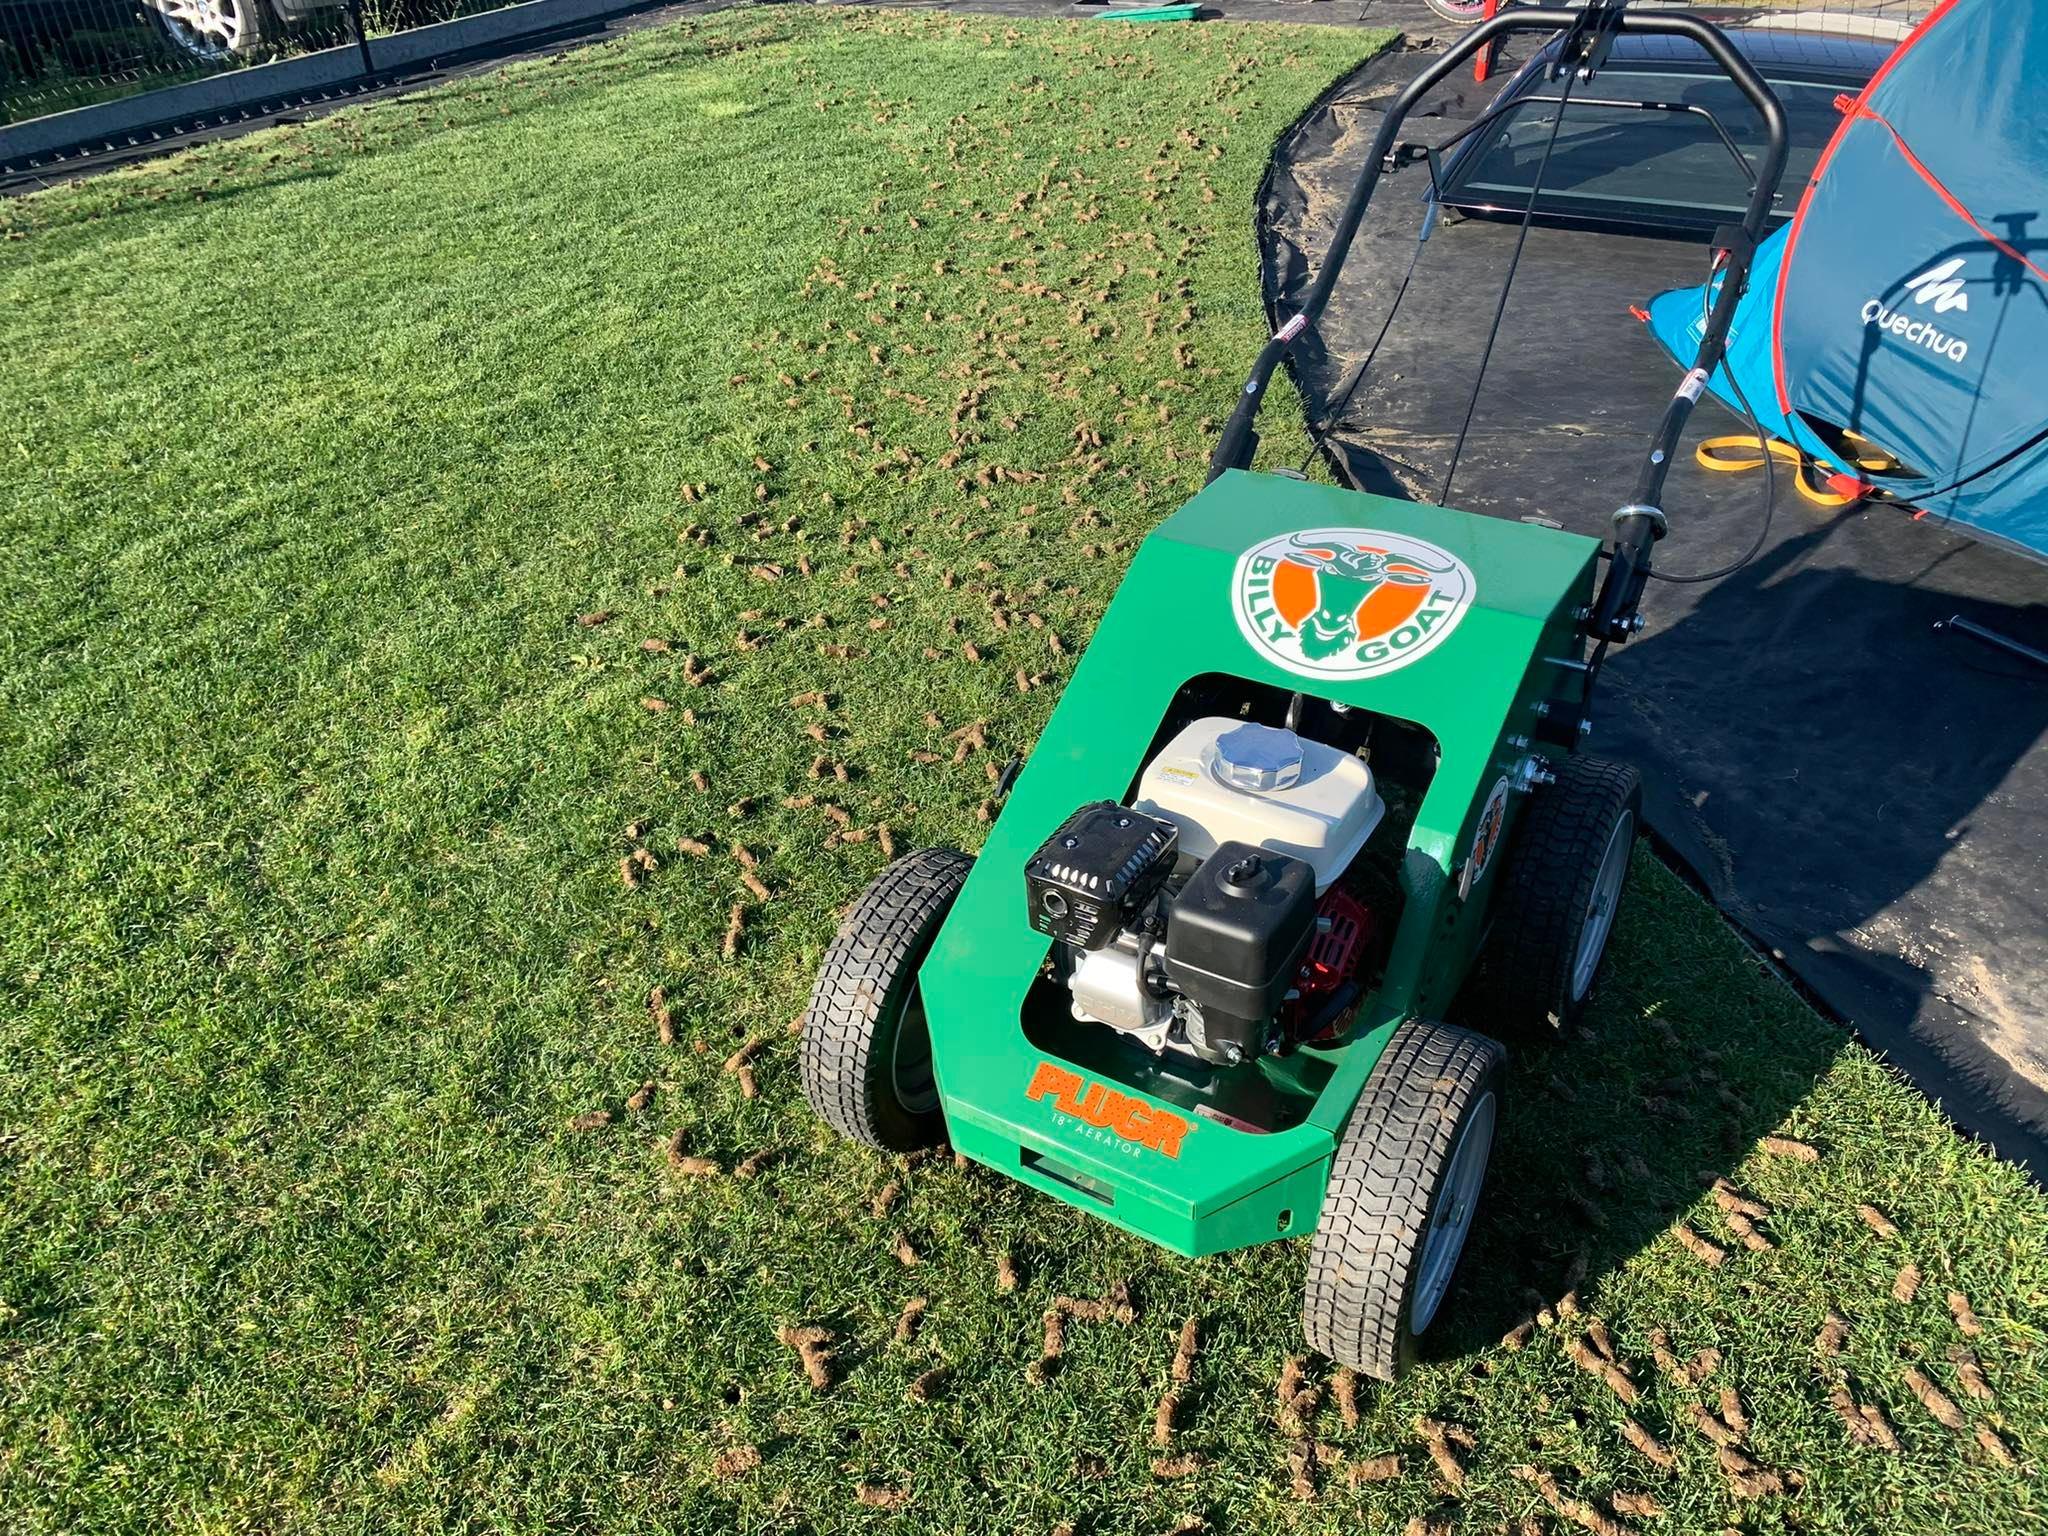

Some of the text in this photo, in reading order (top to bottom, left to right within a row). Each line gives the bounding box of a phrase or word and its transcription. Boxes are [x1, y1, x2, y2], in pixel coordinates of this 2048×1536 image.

[1862, 299, 1968, 362] Quechua
[1248, 556, 1455, 663] BILLY GOAT
[1076, 1123, 1142, 1159] AERATOR
